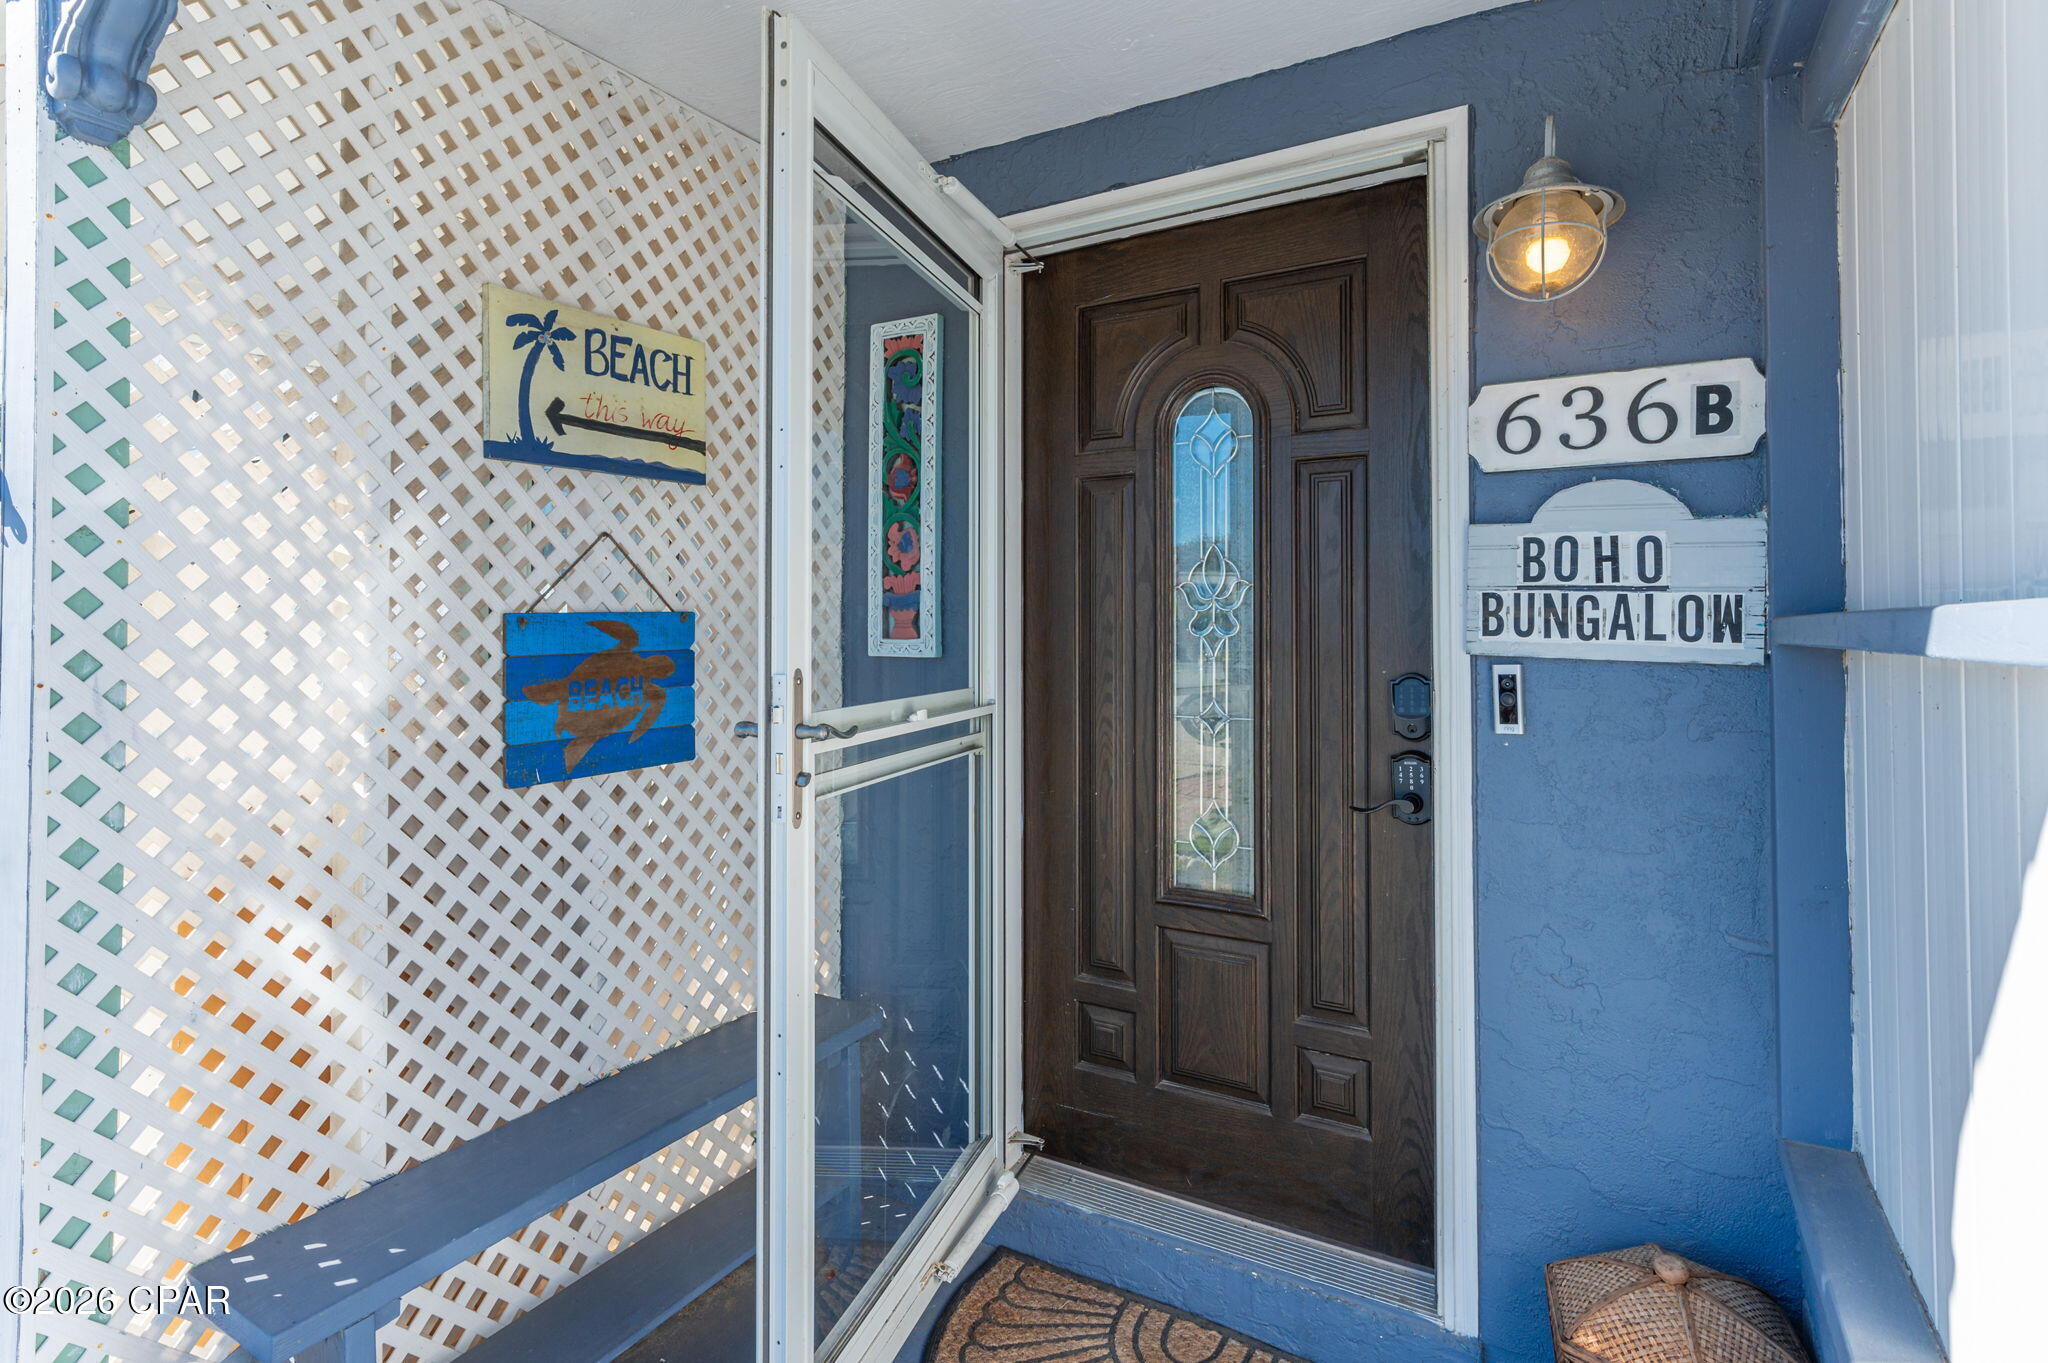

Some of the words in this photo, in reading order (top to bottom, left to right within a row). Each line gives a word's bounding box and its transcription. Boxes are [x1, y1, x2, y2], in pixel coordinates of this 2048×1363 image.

[585, 328, 695, 396] BEACH
[579, 393, 629, 424] this
[641, 411, 695, 450] way
[1522, 535, 1664, 584] BOHO
[1481, 592, 1744, 644] BUNGALOW
[567, 676, 644, 712] BEACH
